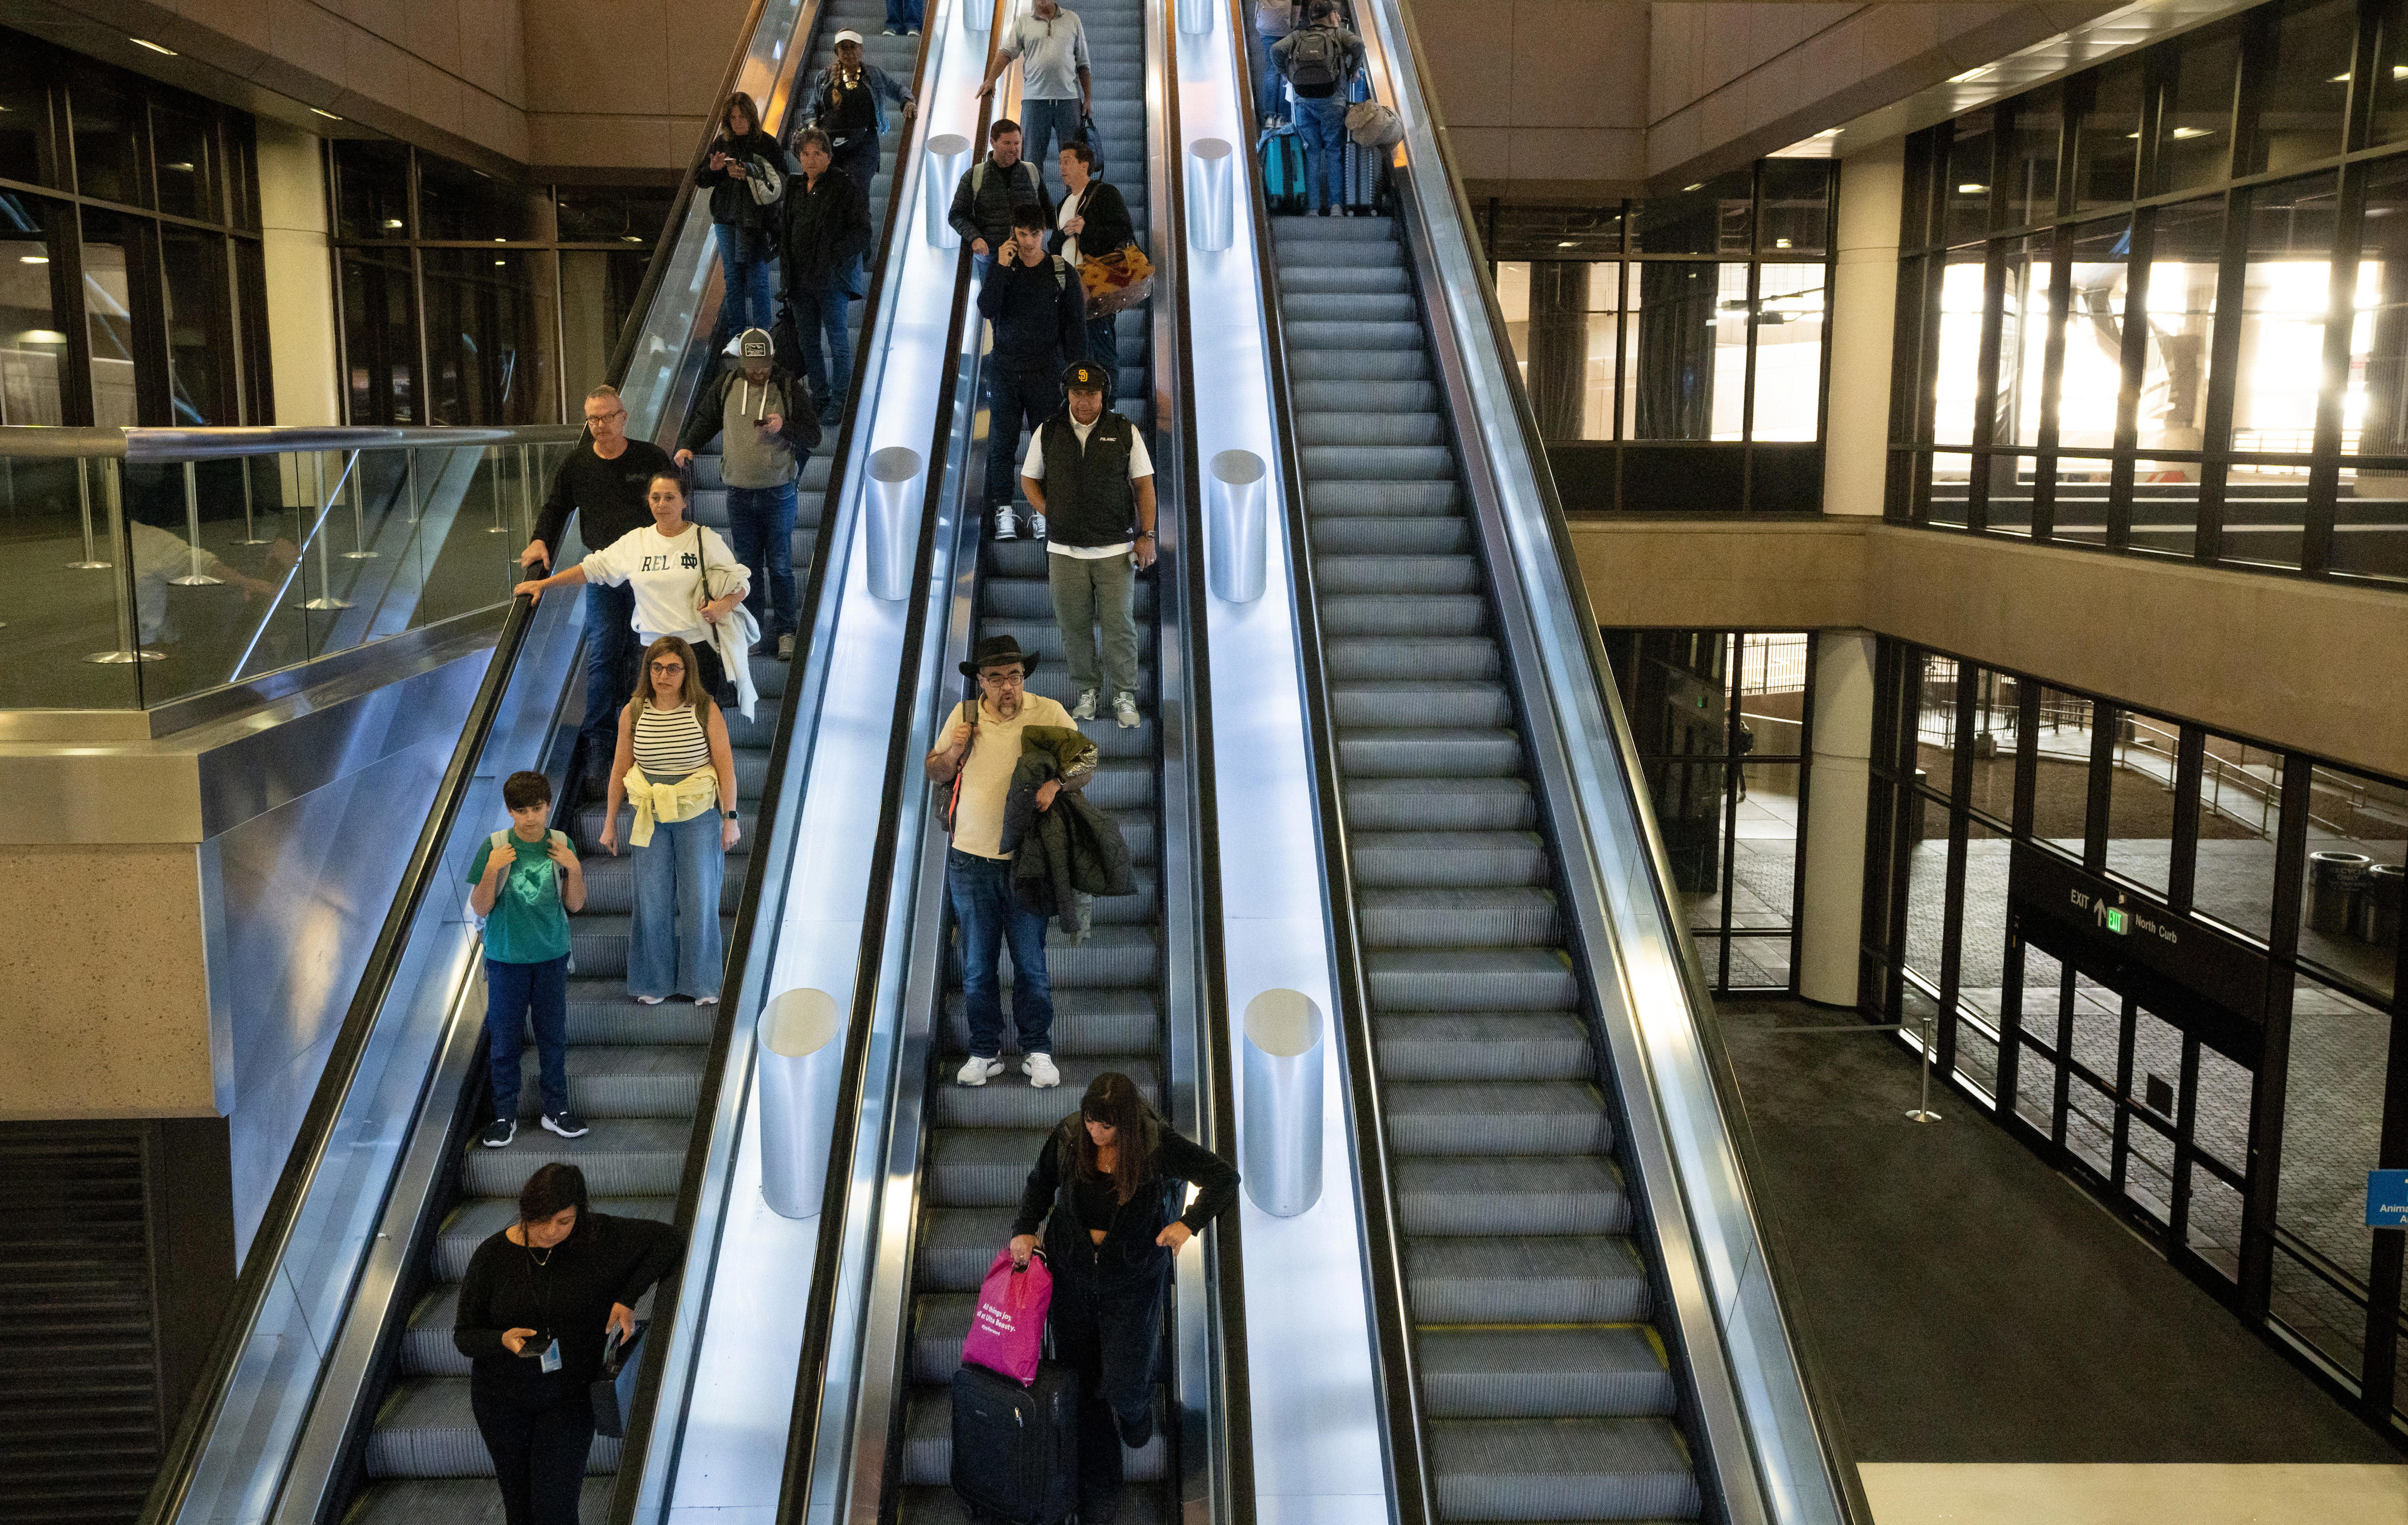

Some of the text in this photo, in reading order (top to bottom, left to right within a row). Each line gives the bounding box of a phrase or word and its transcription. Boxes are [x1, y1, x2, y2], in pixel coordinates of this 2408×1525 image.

[1078, 369, 1088, 382] SD
[2071, 889, 2177, 944] EXIT North Curb
[2108, 909, 2122, 932] EXIT
[988, 1306, 1002, 1317] things
[986, 1314, 995, 1324] Ulta
[996, 1319, 1016, 1332] Beauty.
